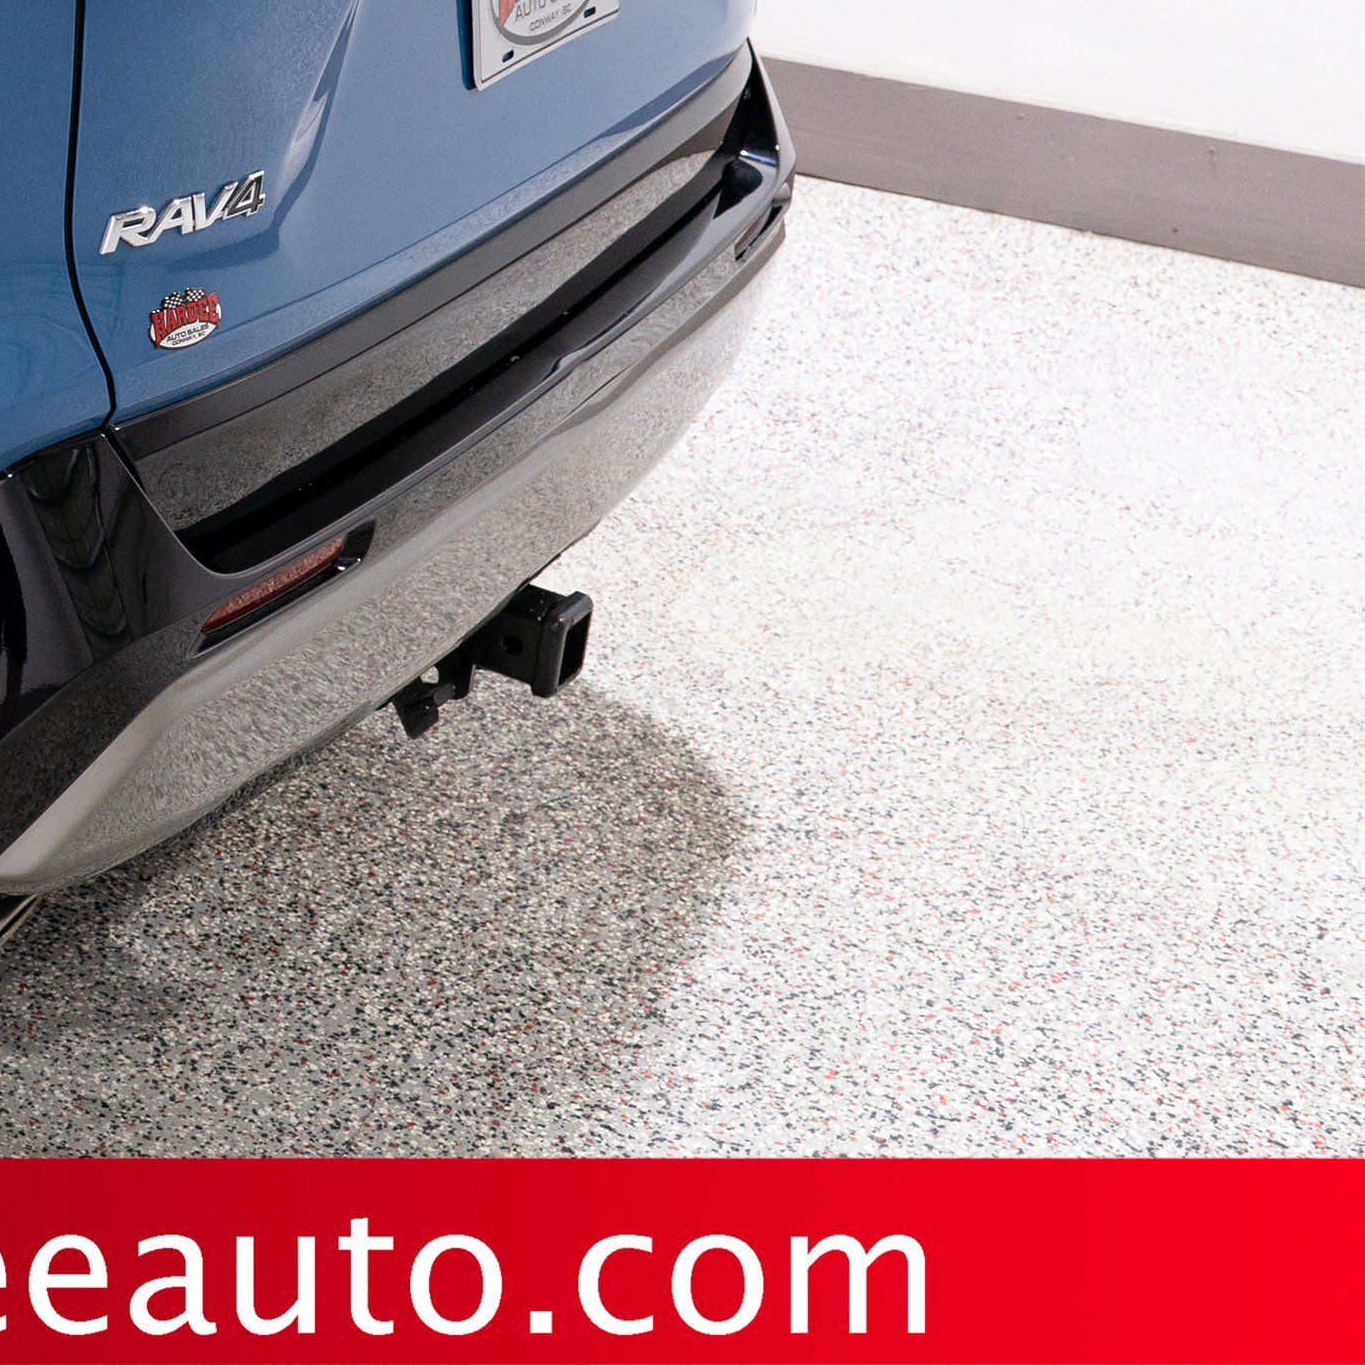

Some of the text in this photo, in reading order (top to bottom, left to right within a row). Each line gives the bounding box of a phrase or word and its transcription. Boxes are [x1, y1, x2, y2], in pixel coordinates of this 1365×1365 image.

[98, 170, 266, 255] RAV4
[151, 293, 219, 346] HARDEE
[166, 322, 209, 342] AUTO SALES
